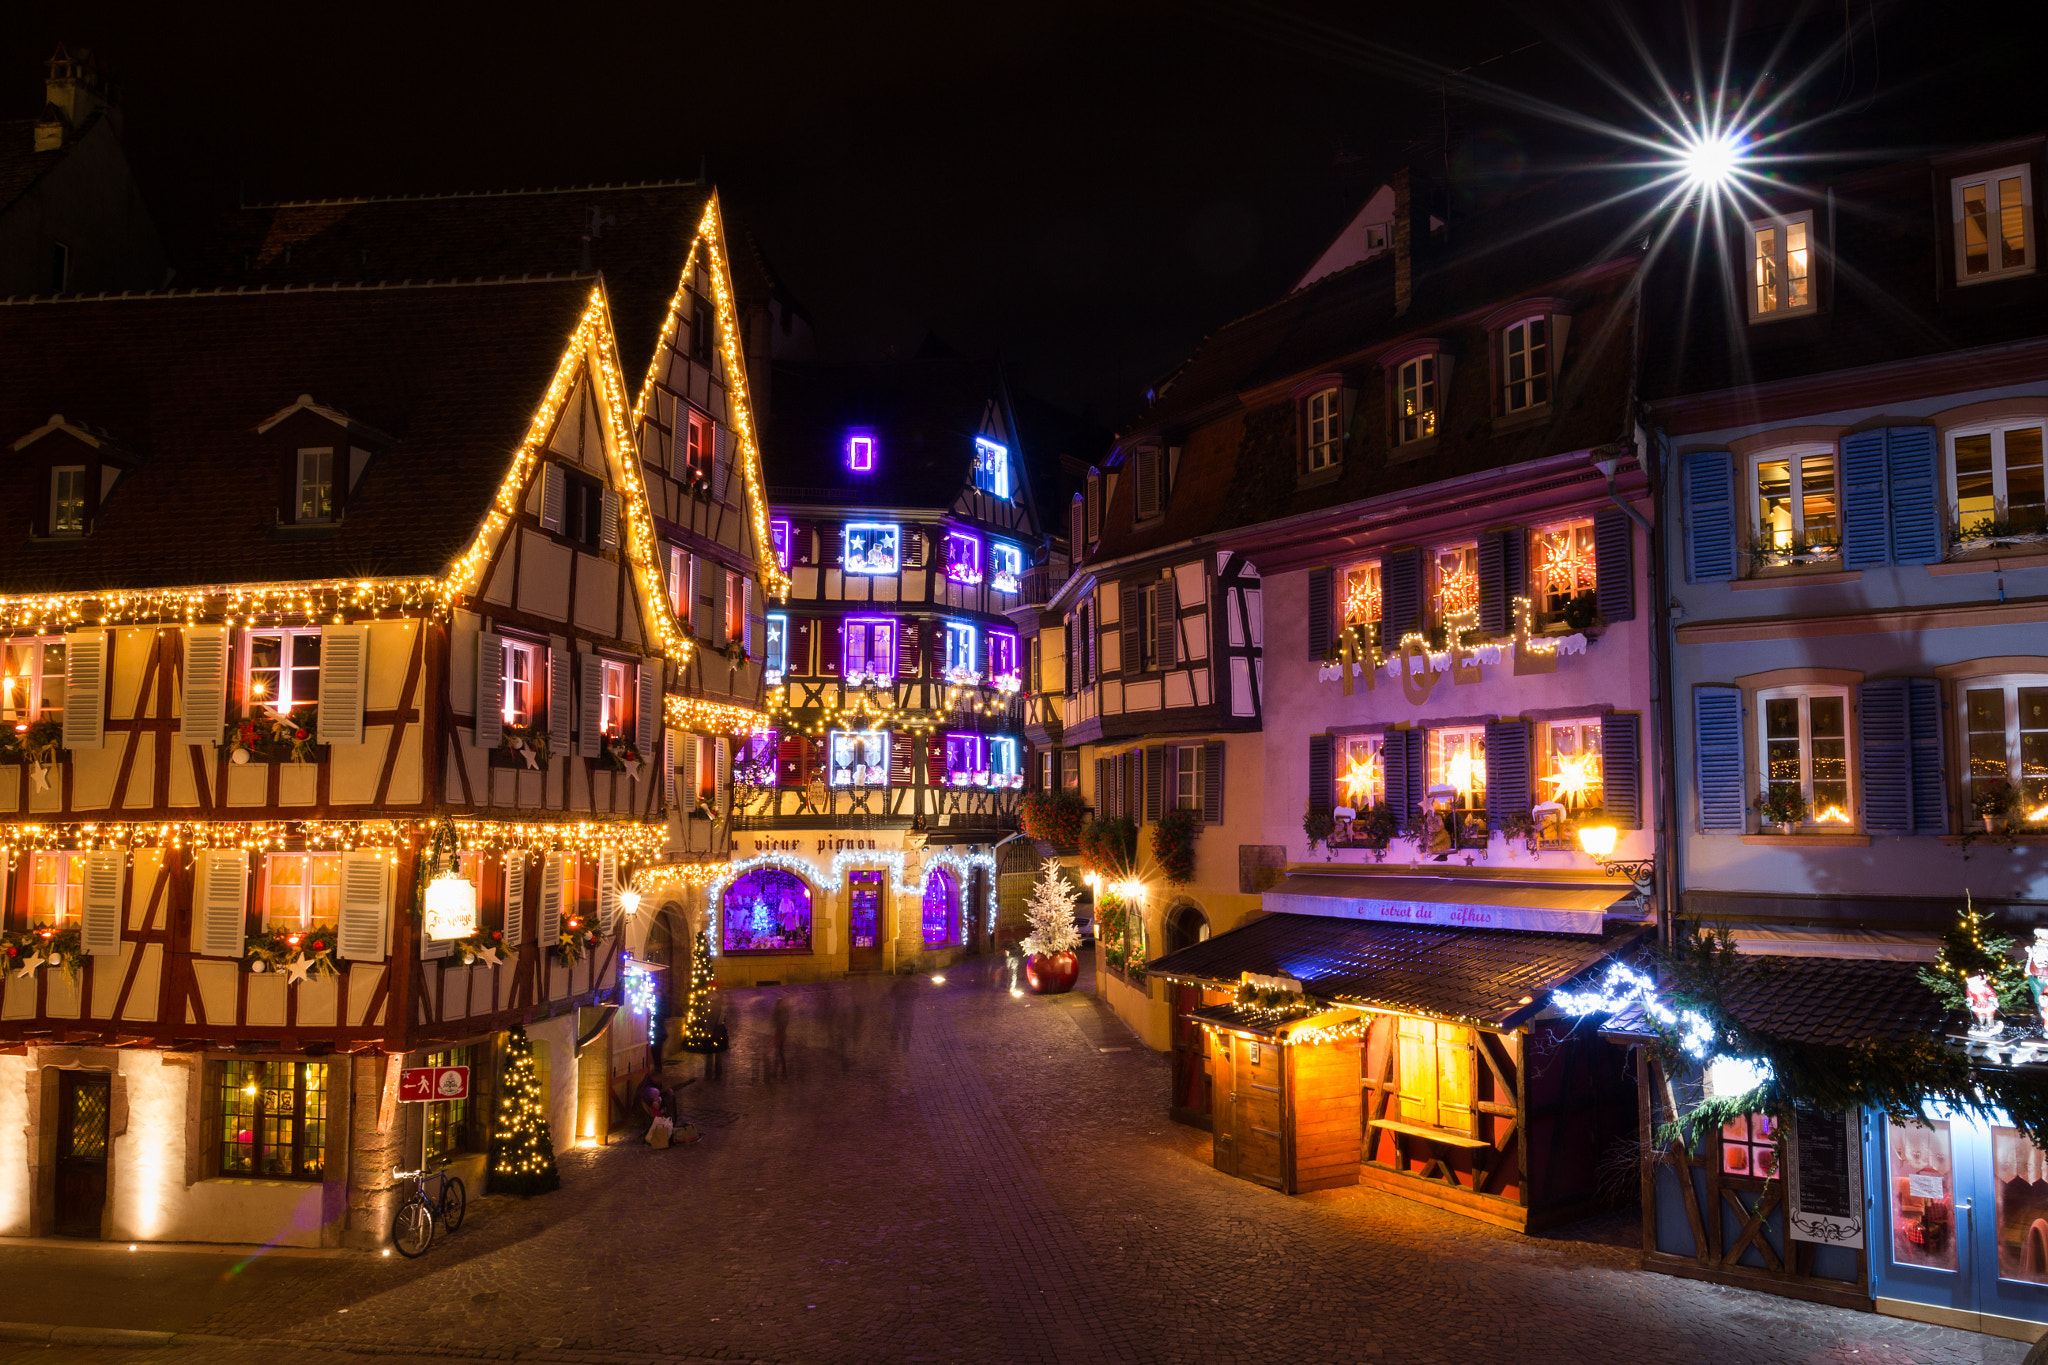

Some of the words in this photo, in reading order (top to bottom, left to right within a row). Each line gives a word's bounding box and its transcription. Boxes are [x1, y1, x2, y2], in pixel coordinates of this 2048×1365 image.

[1341, 597, 1558, 706] NOEL
[754, 834, 800, 851] vieux
[817, 834, 876, 855] pignon
[1415, 905, 1432, 919] du
